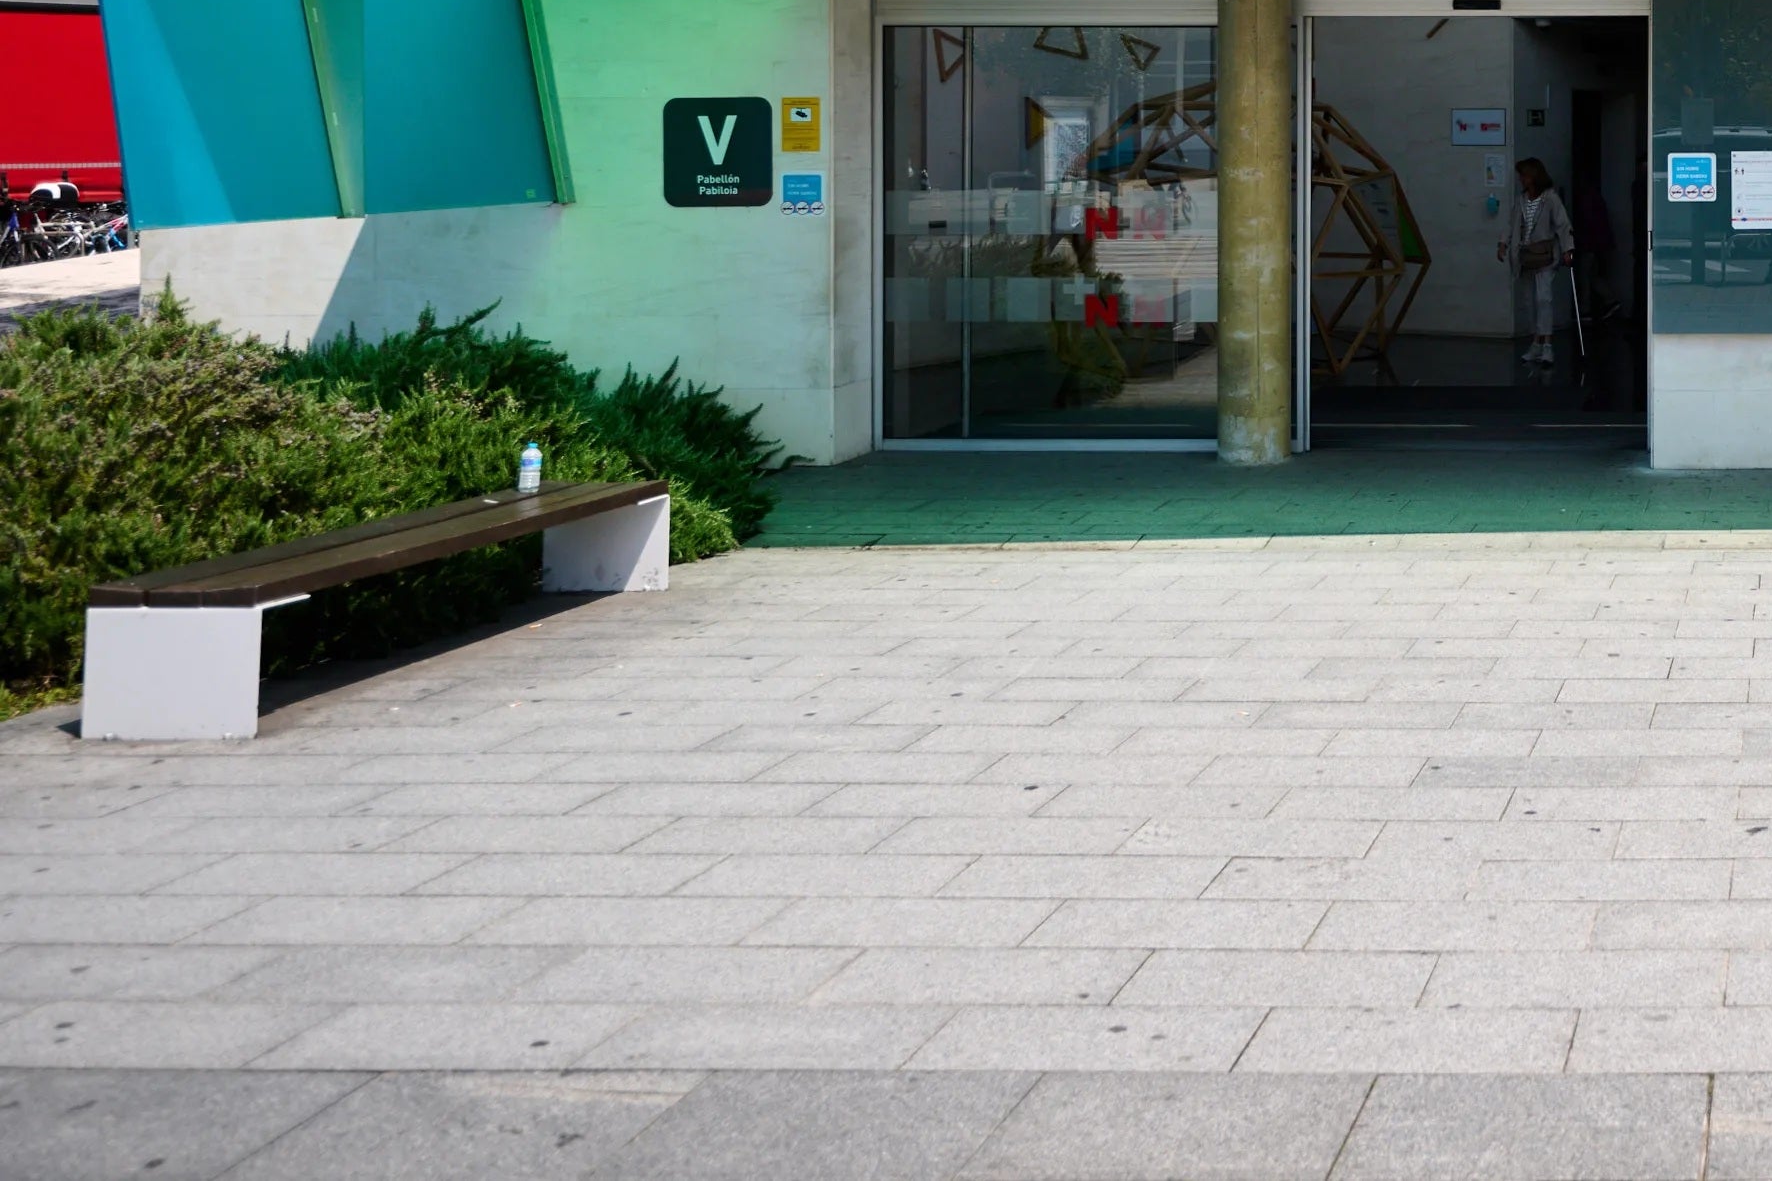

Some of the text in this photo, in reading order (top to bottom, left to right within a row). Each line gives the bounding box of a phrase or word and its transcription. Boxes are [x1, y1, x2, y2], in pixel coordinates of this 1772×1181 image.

[697, 114, 738, 166] V
[697, 174, 740, 184] Pabellón
[699, 185, 738, 195] Pabiloia
[1085, 207, 1119, 241] N
[1085, 294, 1119, 328] N
